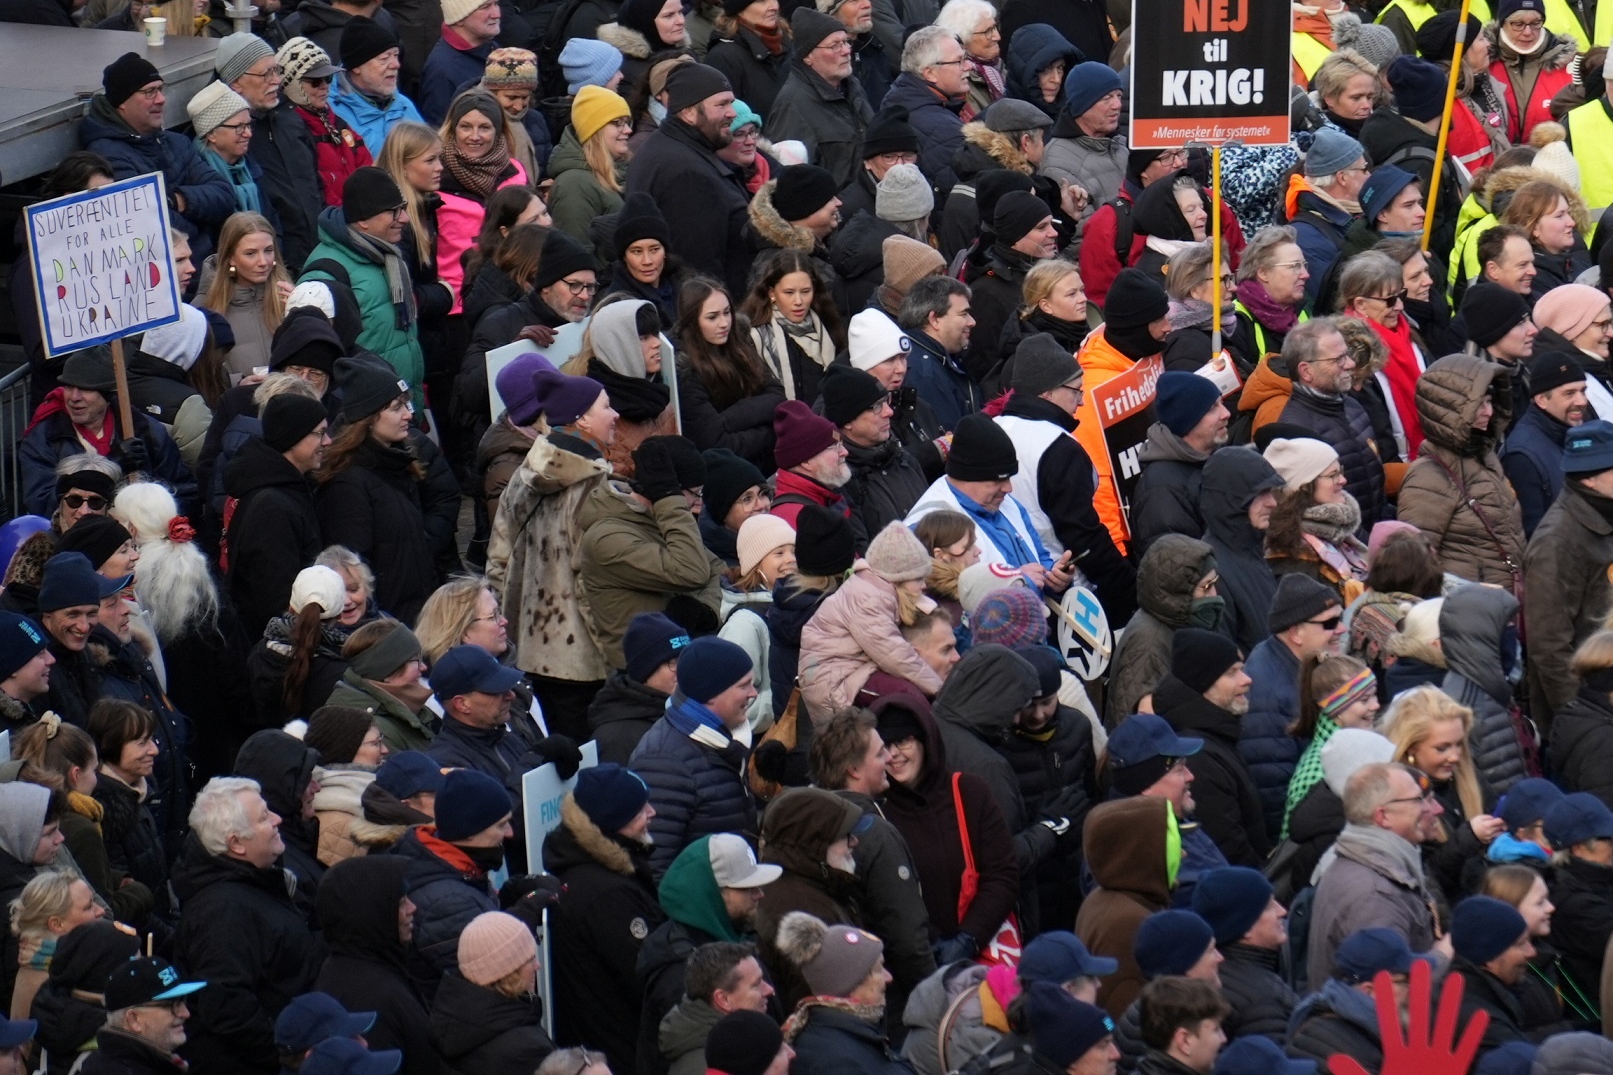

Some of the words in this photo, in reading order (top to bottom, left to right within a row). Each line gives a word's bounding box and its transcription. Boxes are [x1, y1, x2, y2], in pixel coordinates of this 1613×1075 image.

[1203, 39, 1228, 63] til
[1162, 68, 1264, 106] KRIG!
[34, 184, 151, 238] SUVERÆNITET
[67, 231, 89, 252] FOR
[100, 219, 134, 241] ALLE
[54, 233, 158, 283] DANMARK
[57, 261, 161, 314] RUSLAND
[62, 299, 158, 339] UKRAINE
